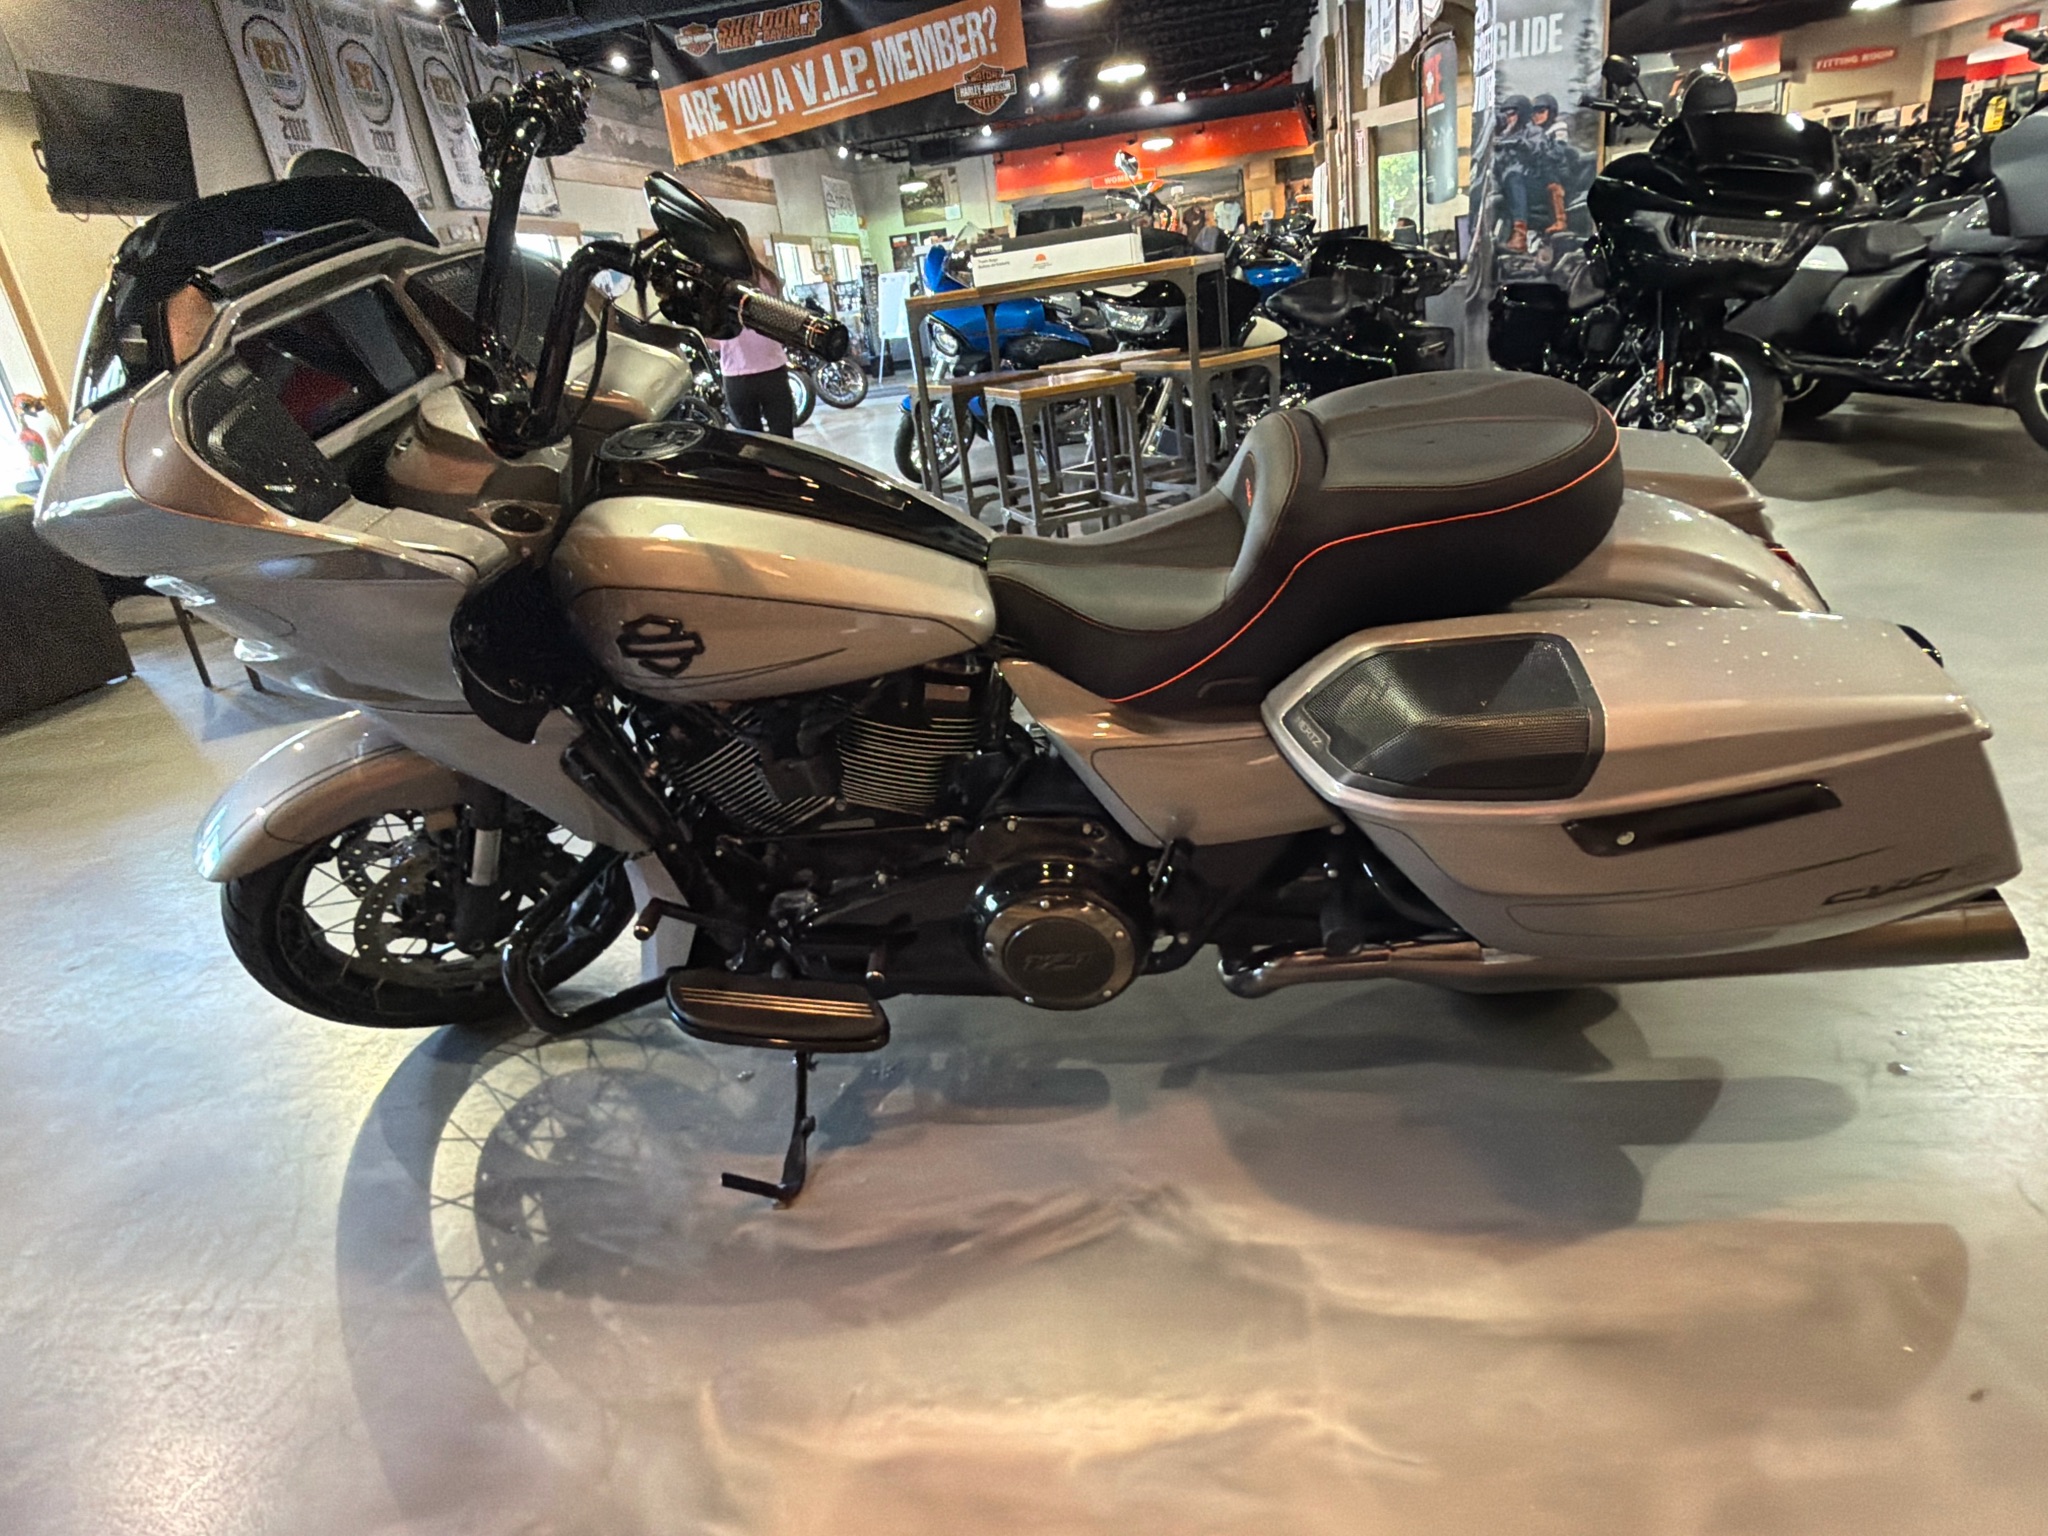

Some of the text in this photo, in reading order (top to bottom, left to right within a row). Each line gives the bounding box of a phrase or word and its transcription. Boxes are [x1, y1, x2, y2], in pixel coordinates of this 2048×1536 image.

[718, 1, 821, 37] SHELDON'S
[1494, 12, 1564, 61] GLIDE
[679, 5, 998, 140] ARE YOU A V.I.P. MEMBER?
[1816, 54, 1859, 70] FITTING
[1104, 172, 1143, 185] WOMES
